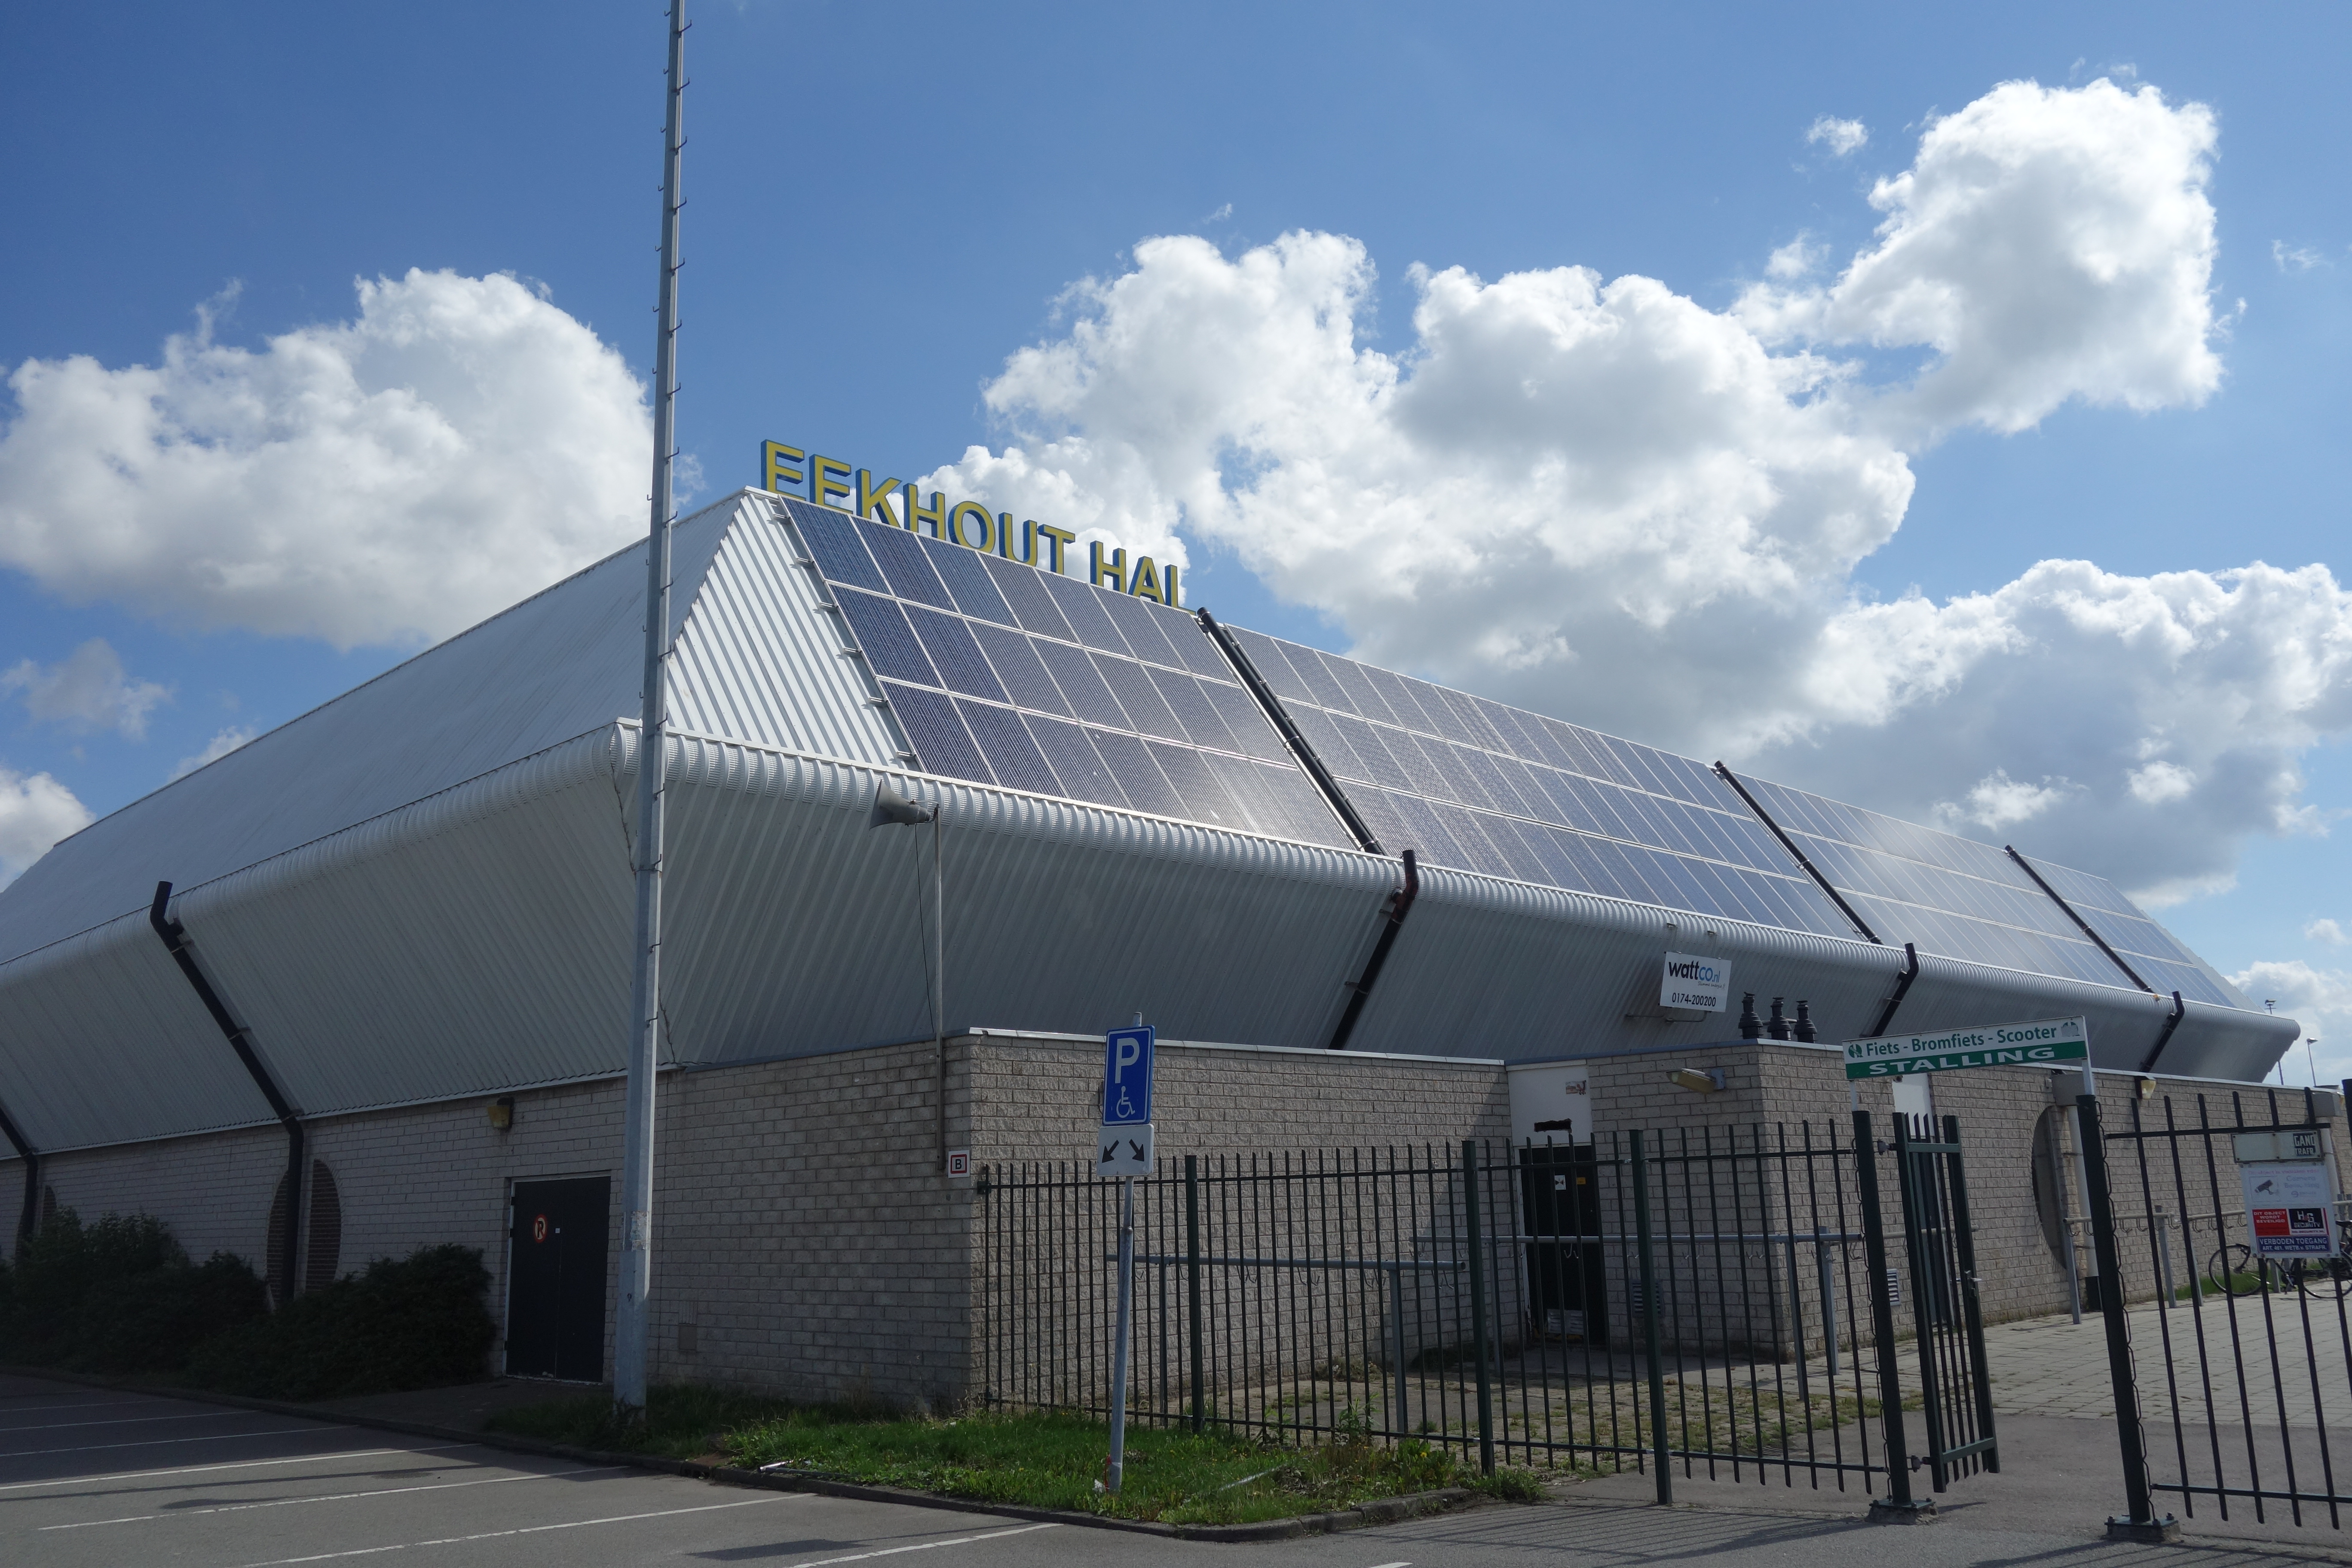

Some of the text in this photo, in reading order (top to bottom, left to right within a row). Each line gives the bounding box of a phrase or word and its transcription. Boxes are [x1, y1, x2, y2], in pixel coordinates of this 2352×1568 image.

[760, 439, 1075, 575] EEKHOUT
[1672, 992, 1716, 1007] 0174-200200
[1866, 1042, 1900, 1057] Fiets
[1911, 1033, 1984, 1052] Bromfiets
[1997, 1027, 2057, 1043] Scooter
[1115, 1037, 1140, 1084] P
[1869, 1047, 2055, 1075] STALLING
[955, 1159, 962, 1170] B
